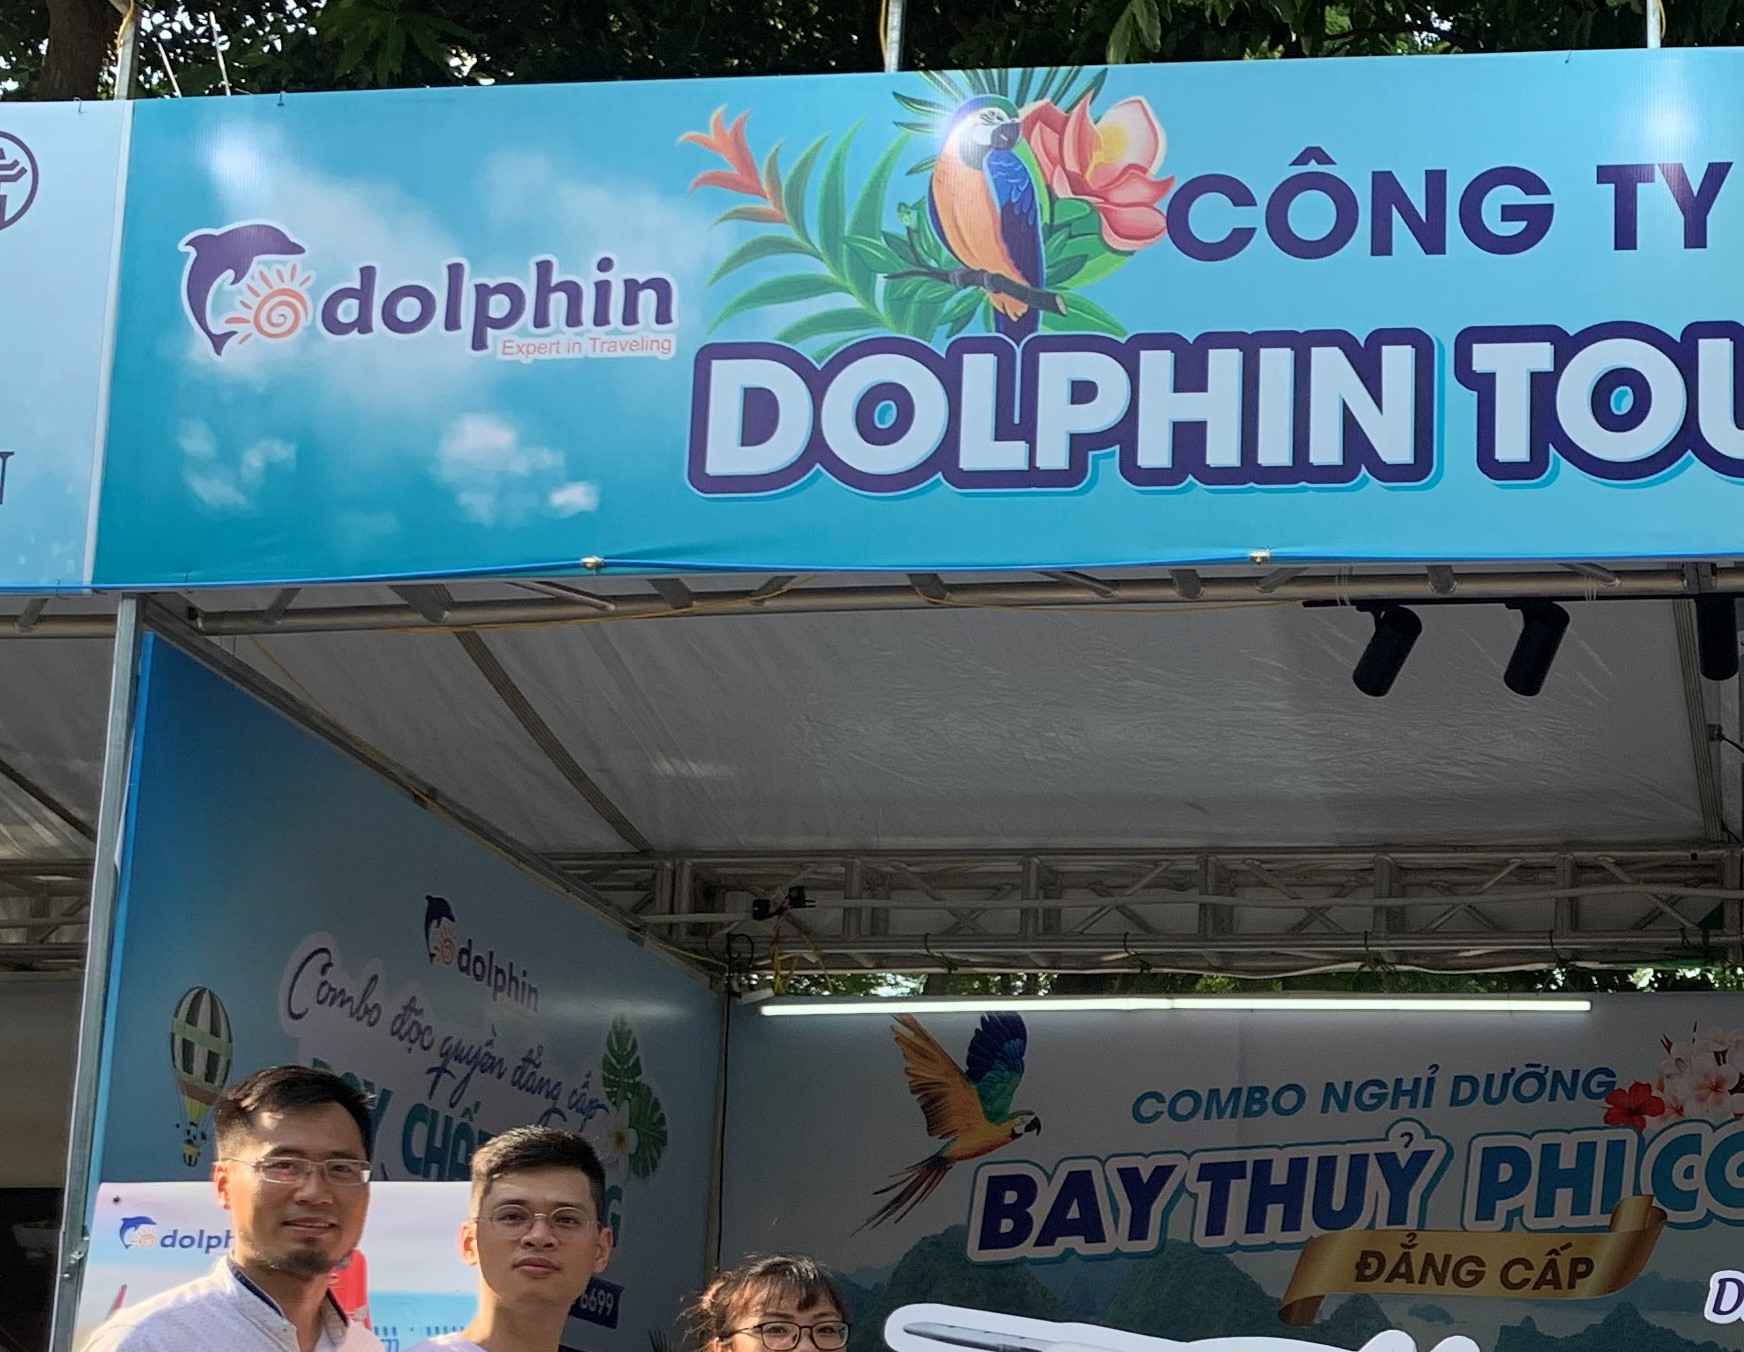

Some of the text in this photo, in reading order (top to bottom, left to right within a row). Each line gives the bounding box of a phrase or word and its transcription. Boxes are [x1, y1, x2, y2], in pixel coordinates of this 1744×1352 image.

[1167, 146, 1554, 262] CÔNG
[1597, 162, 1733, 250] TY
[321, 257, 674, 352] dolphin
[502, 336, 672, 358] Expert in Traveling
[697, 336, 1424, 486] DOLPHIN
[287, 947, 383, 1028] Combo
[458, 939, 540, 1013] dolphin
[1132, 1062, 1617, 1125] COMBO NGHỈ DƯỠNG
[976, 1161, 1180, 1253] BAY
[1194, 1130, 1443, 1240] THUỶ
[1474, 1127, 1637, 1223] PHI
[1354, 1230, 1596, 1293] ĐẲNG CẤP
